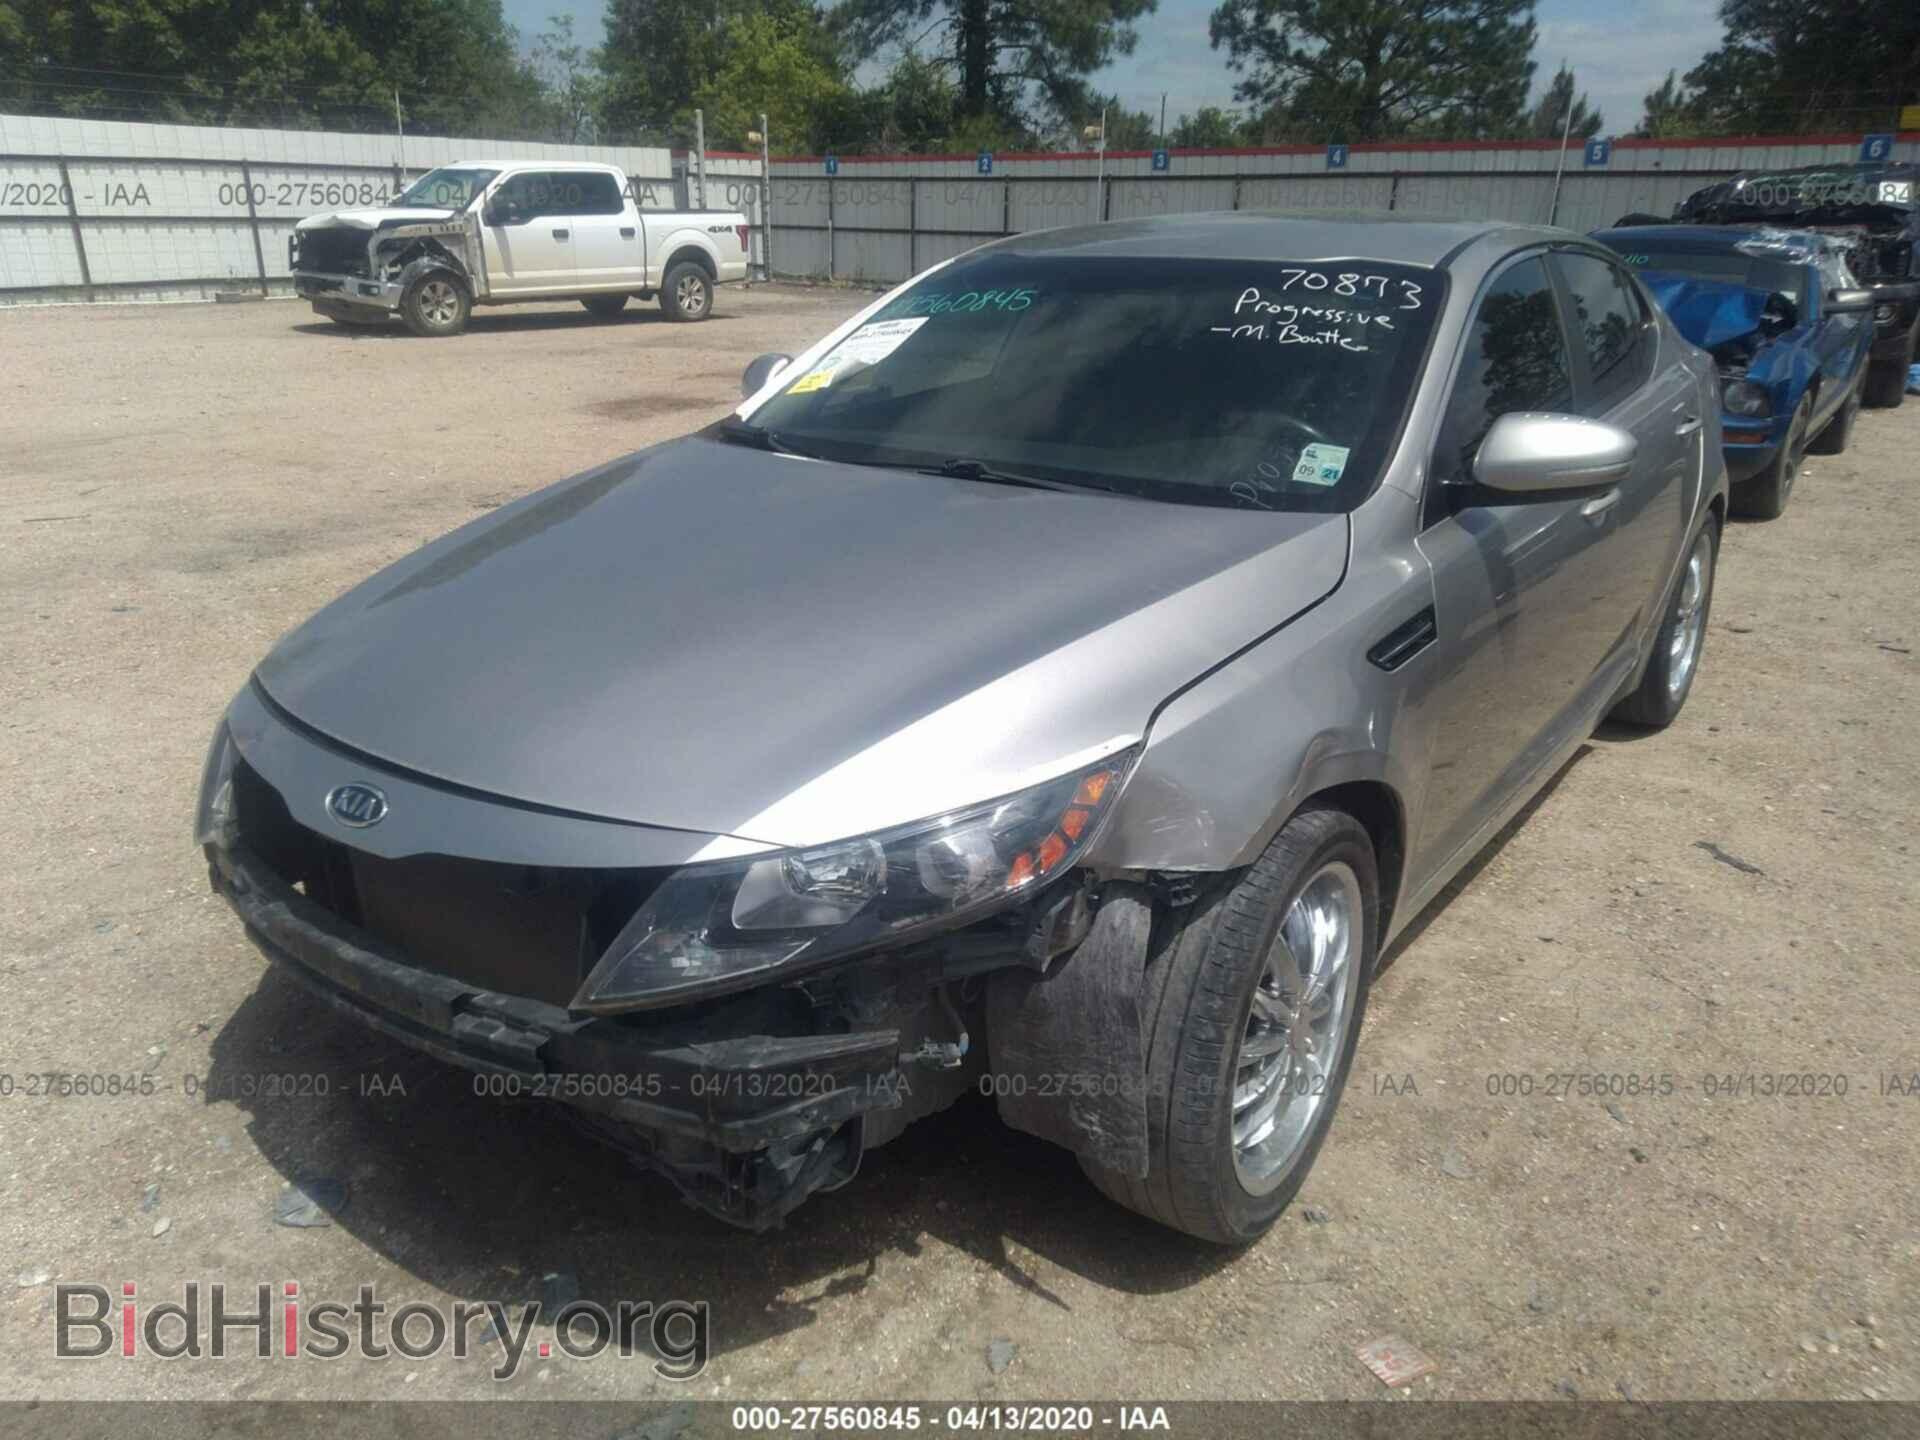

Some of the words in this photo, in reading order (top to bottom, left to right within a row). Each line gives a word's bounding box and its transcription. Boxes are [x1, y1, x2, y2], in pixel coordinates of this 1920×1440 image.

[1332, 149, 1342, 164] 4
[1868, 140, 1883, 157] 6
[1281, 269, 1422, 309] 70873
[1234, 287, 1396, 329] Progressive
[1299, 464, 1315, 476] 09
